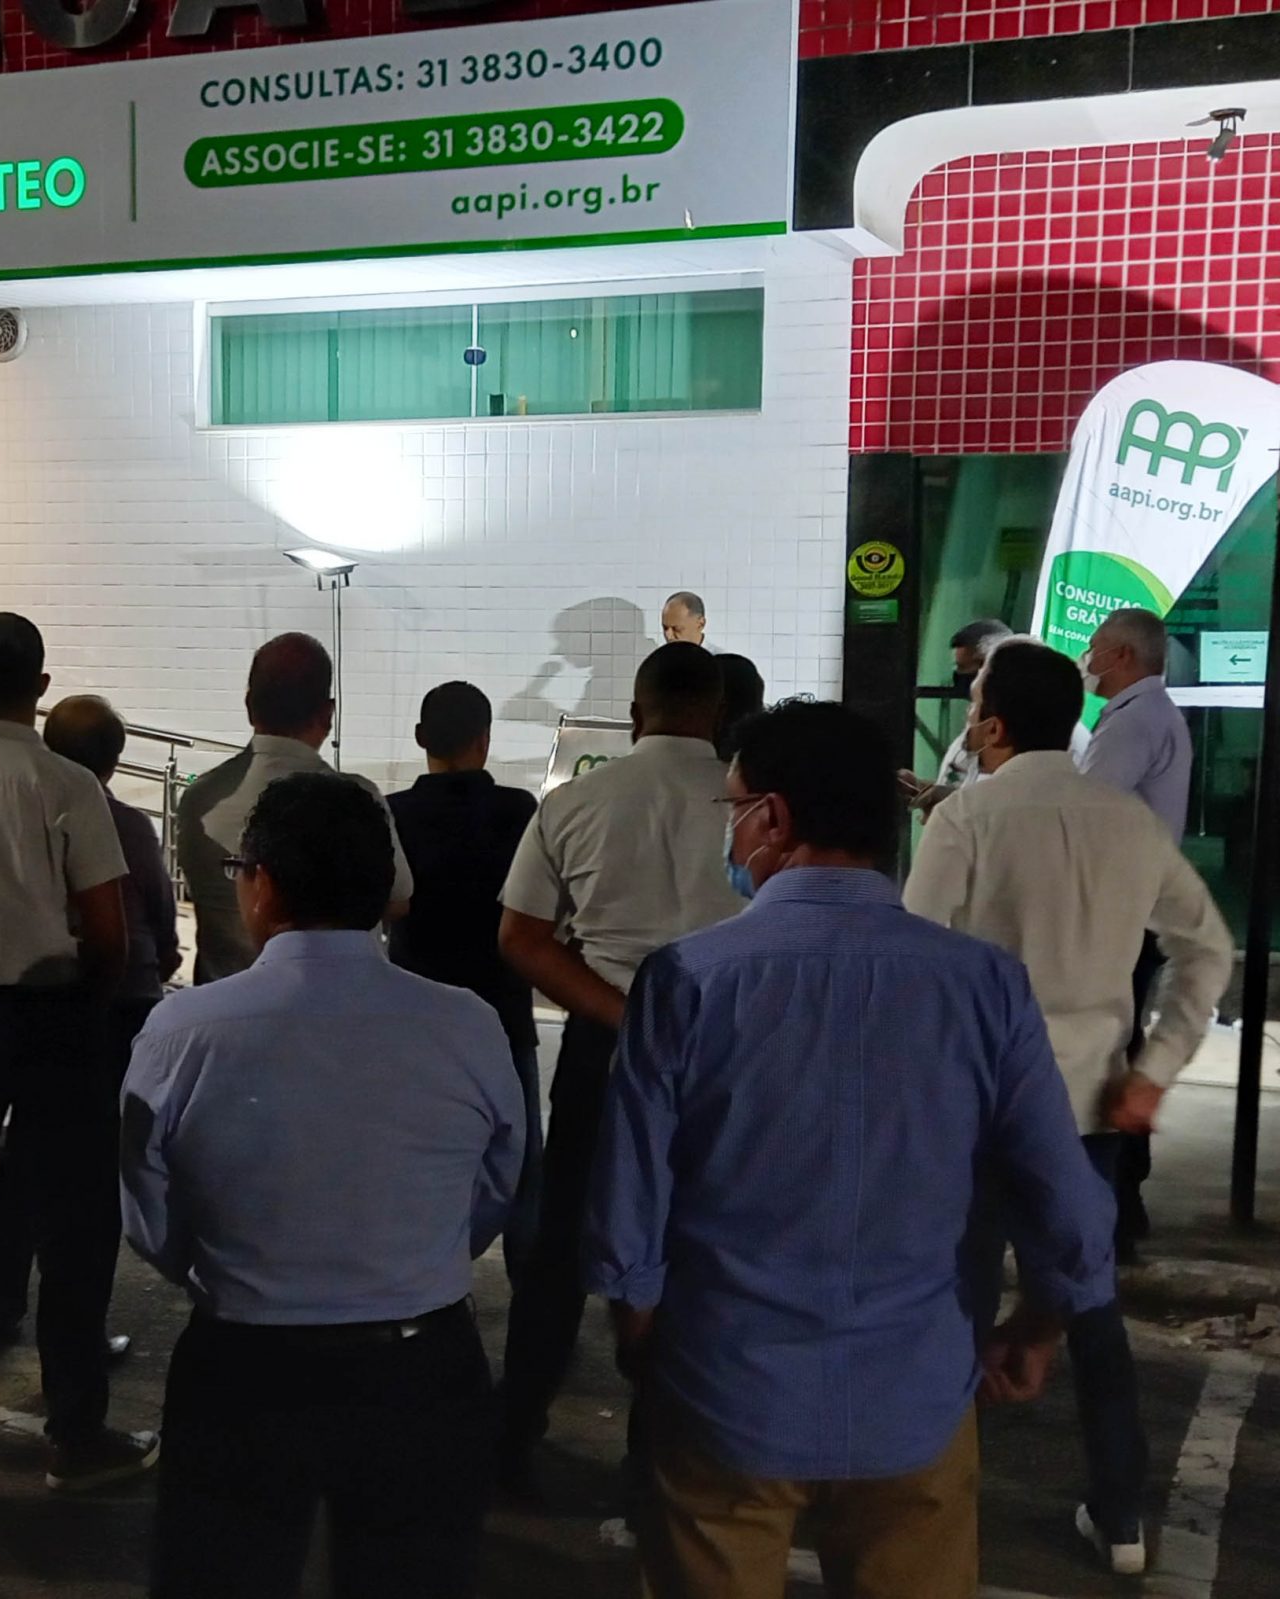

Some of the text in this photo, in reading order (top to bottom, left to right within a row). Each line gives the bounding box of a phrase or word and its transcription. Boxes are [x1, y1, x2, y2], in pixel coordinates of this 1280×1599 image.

[200, 37, 663, 108] CONSULTAS: 31 3830-3400
[200, 111, 665, 178] ASSOCIE-SE: 31 3830-3422
[451, 174, 660, 220] aapi.org.br
[1108, 481, 1223, 523] aapi.org.br
